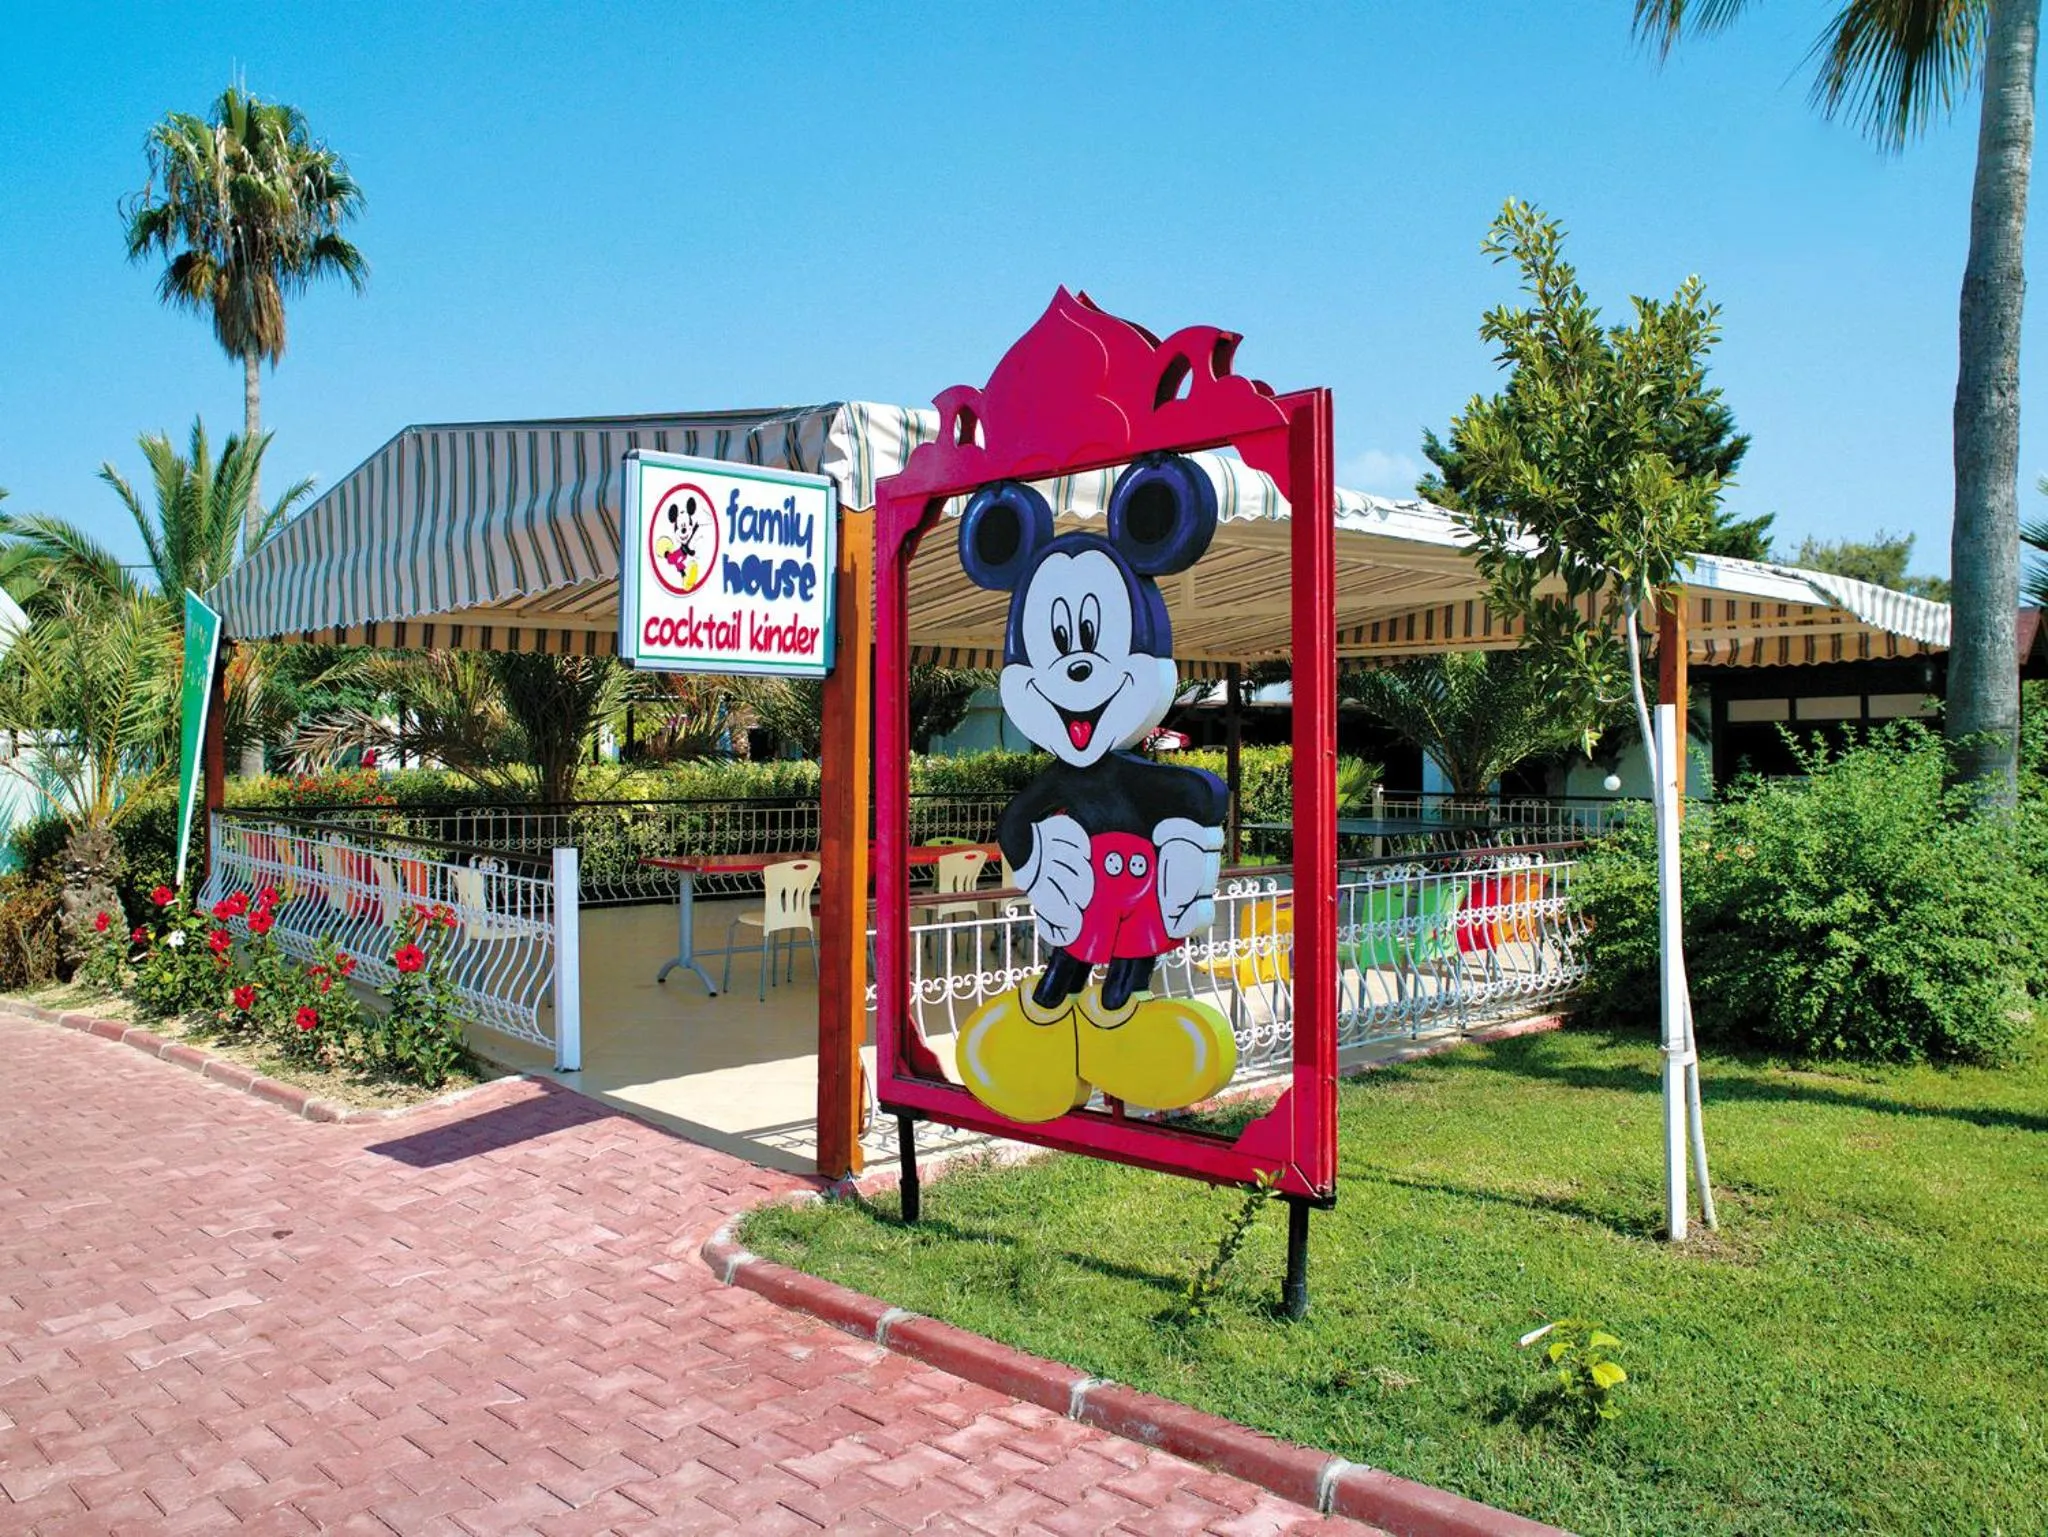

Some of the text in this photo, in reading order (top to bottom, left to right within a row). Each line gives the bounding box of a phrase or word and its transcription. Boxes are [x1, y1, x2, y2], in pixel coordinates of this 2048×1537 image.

[726, 488, 814, 559] family
[723, 553, 816, 602] house
[643, 606, 820, 655] cocktail kinder
